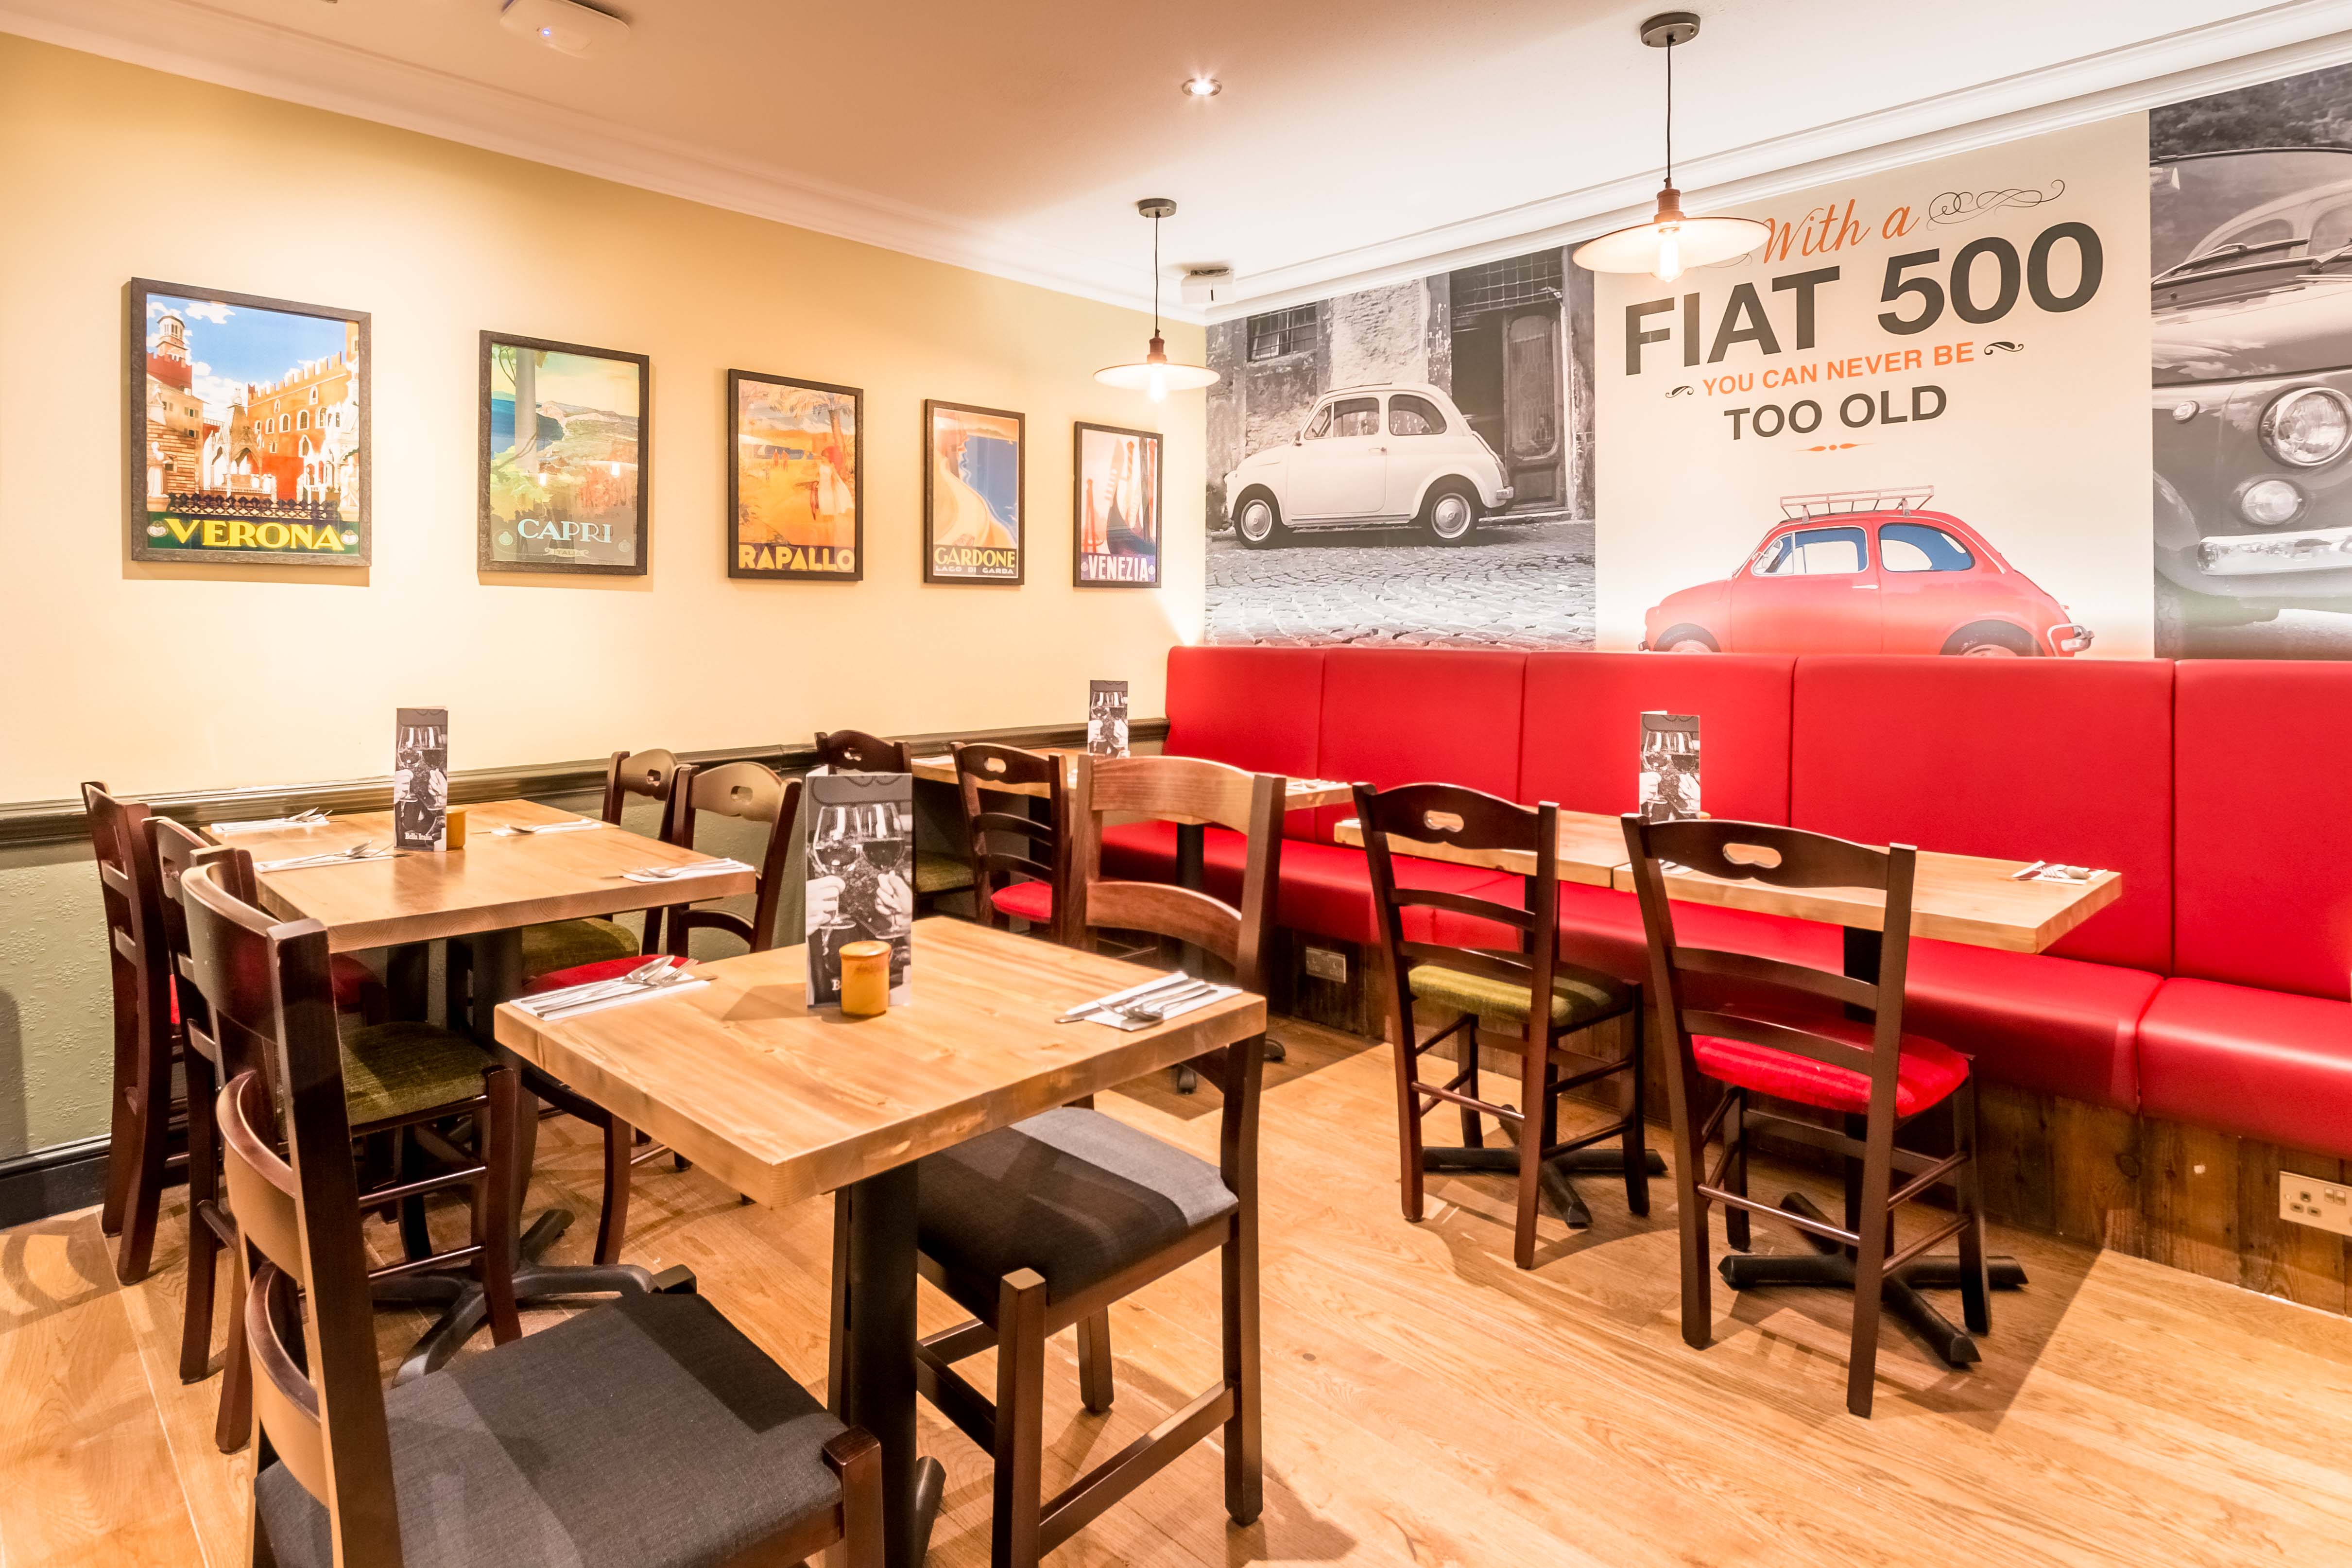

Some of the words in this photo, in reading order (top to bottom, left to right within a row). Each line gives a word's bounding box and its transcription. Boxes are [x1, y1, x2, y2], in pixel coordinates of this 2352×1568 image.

[1762, 199, 1871, 263] With
[1882, 206, 1920, 239] a
[1626, 265, 1840, 376] FIAT
[1877, 221, 2103, 335] 500
[1702, 372, 1754, 396] YOU
[1762, 364, 1818, 389] CAN
[1827, 348, 1922, 380] NEVER
[1934, 342, 1974, 367] BE
[1724, 399, 1822, 440] TOO
[1839, 385, 1947, 428] OLD
[164, 518, 345, 551] VERONA
[517, 518, 612, 543] CAPRI
[738, 544, 855, 571] RAPALLO
[934, 547, 1015, 568] GARDONE
[1088, 554, 1149, 582] VENEZIA
